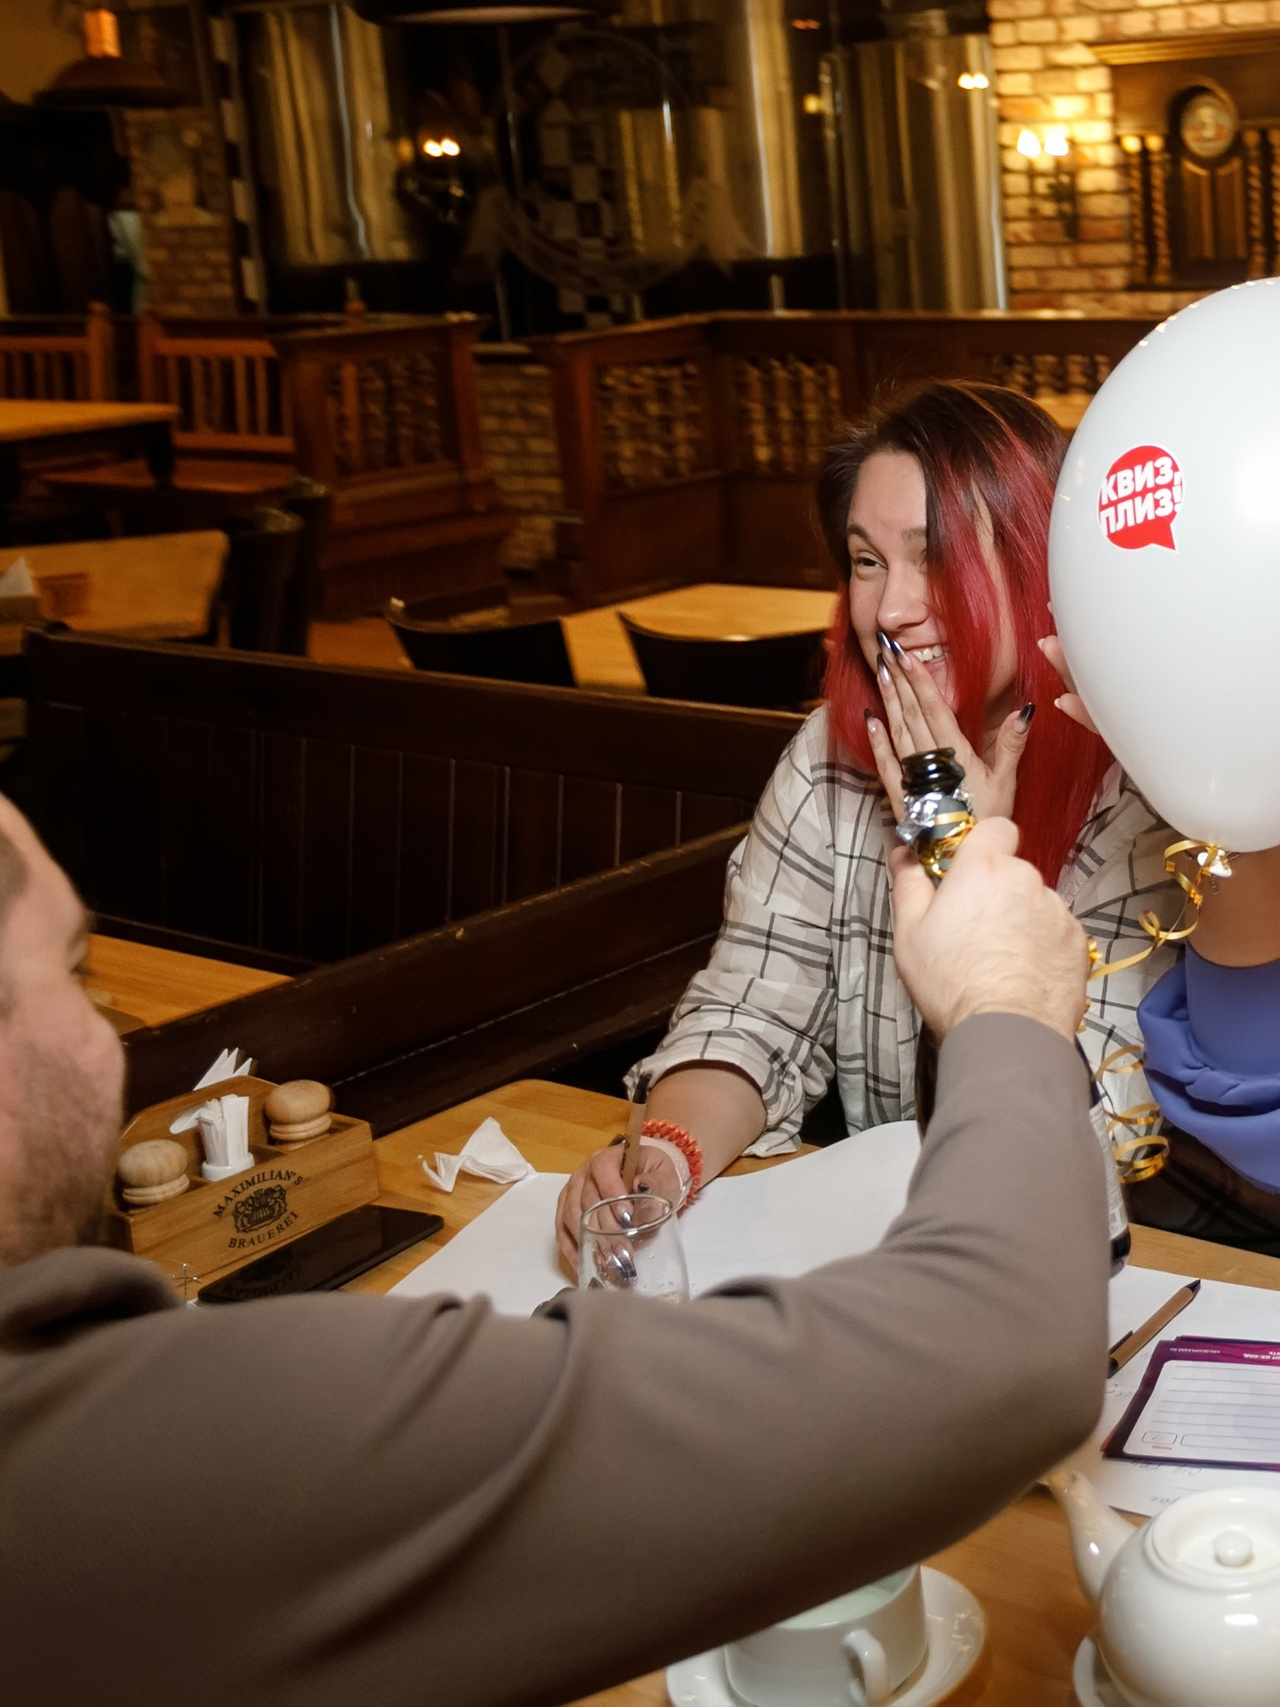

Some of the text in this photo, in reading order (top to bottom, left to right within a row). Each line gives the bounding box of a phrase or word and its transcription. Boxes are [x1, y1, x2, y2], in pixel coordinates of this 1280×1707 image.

[1101, 456, 1183, 506] КВИЗ,
[1099, 485, 1182, 535] ПЛИЗ!
[212, 1168, 304, 1218] MAXIMILIAN'S
[227, 1211, 300, 1250] BRAUEREI
